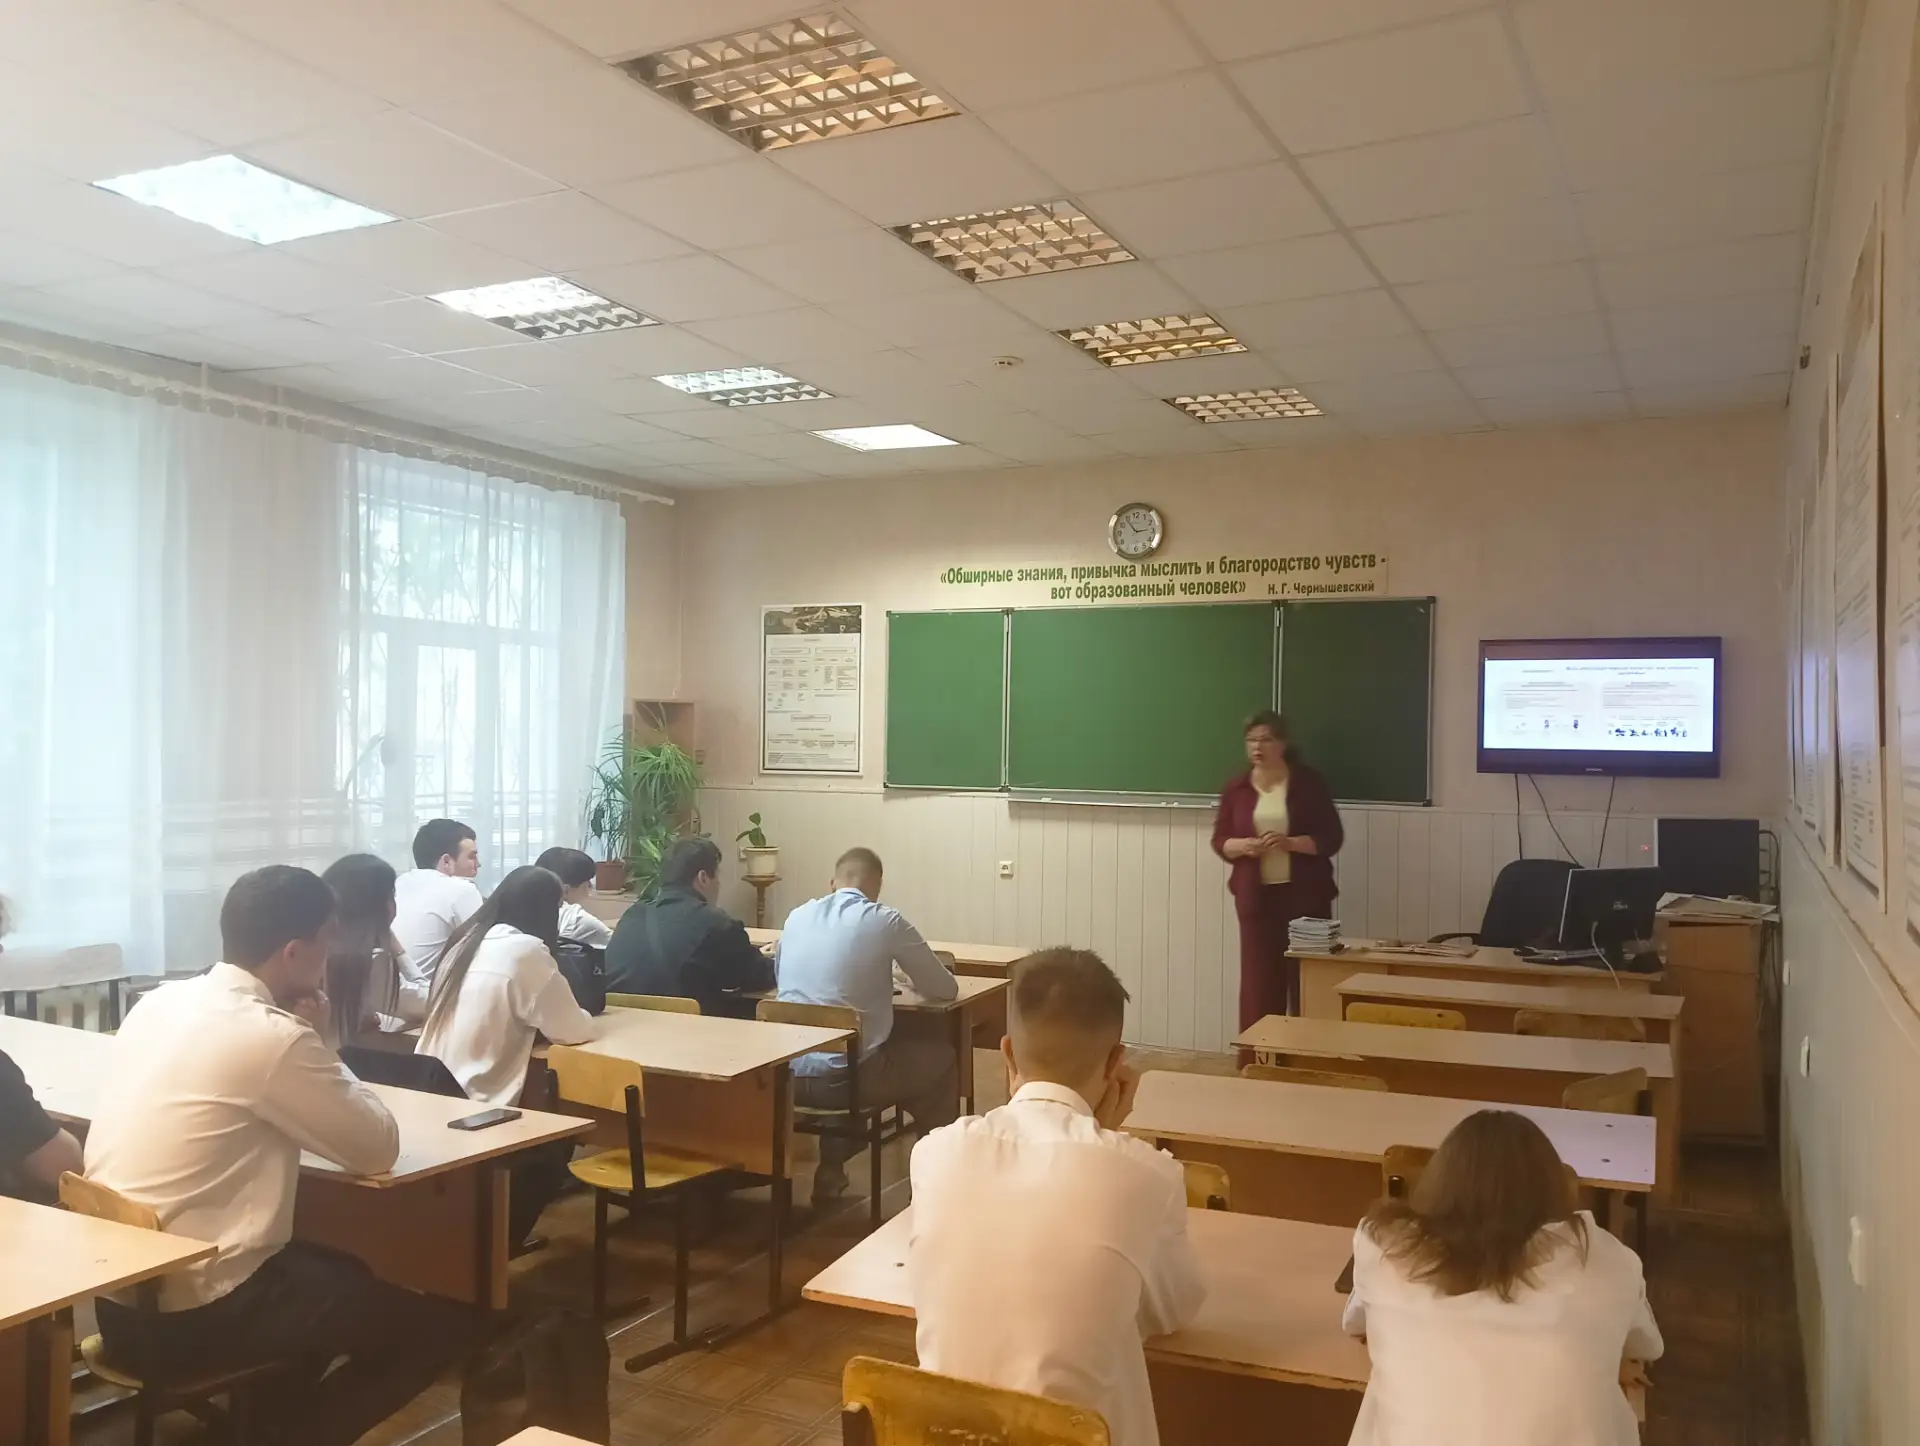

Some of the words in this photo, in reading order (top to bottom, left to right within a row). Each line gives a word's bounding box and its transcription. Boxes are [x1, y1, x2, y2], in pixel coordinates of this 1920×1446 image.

[940, 567, 1013, 587] «Обширные
[1017, 566, 1067, 584] знания,
[1071, 564, 1136, 583] привычка
[1140, 561, 1201, 577] мыслить
[1206, 561, 1215, 574] и
[1219, 556, 1320, 576] благородство
[1326, 554, 1376, 574] чувств
[1051, 586, 1071, 600] вот
[1075, 578, 1175, 602] образованный
[1179, 579, 1246, 596] человек»
[1268, 583, 1278, 595] Н.
[1281, 582, 1290, 595] Г.
[1293, 580, 1375, 596] Чернышевский
